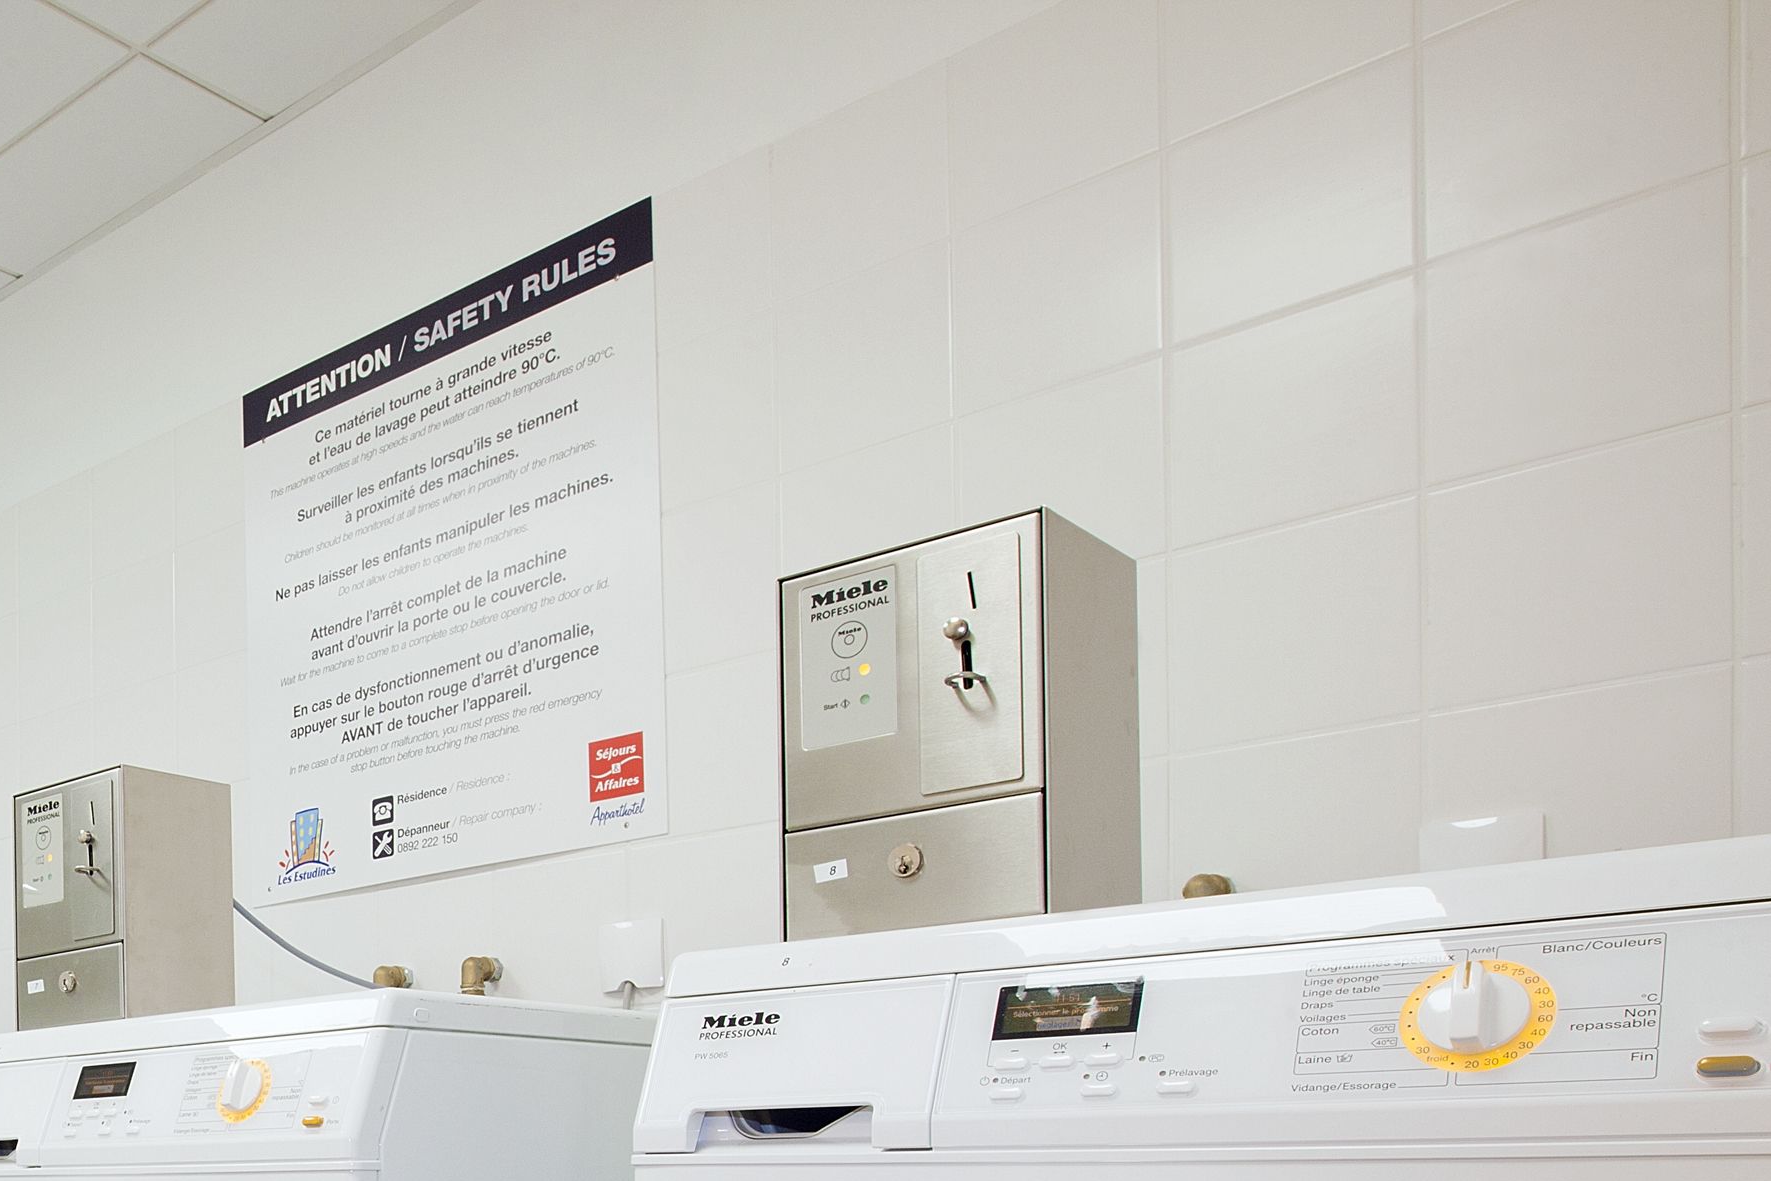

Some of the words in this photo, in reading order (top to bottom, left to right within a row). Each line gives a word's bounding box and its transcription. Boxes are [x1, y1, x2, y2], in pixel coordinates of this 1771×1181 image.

[266, 343, 390, 422] ATTENTION
[397, 335, 406, 361] /
[413, 284, 513, 351] SAFETY
[522, 237, 615, 302] RULES
[314, 429, 331, 443] Ce
[335, 401, 385, 435] matériel
[388, 385, 431, 411] tourne
[435, 376, 443, 391] à
[447, 355, 496, 388] grande
[500, 331, 552, 361] vitesse
[308, 451, 320, 465] et
[323, 439, 351, 459] l'eau
[355, 431, 371, 446] de
[374, 412, 416, 438] lavage
[420, 395, 450, 422] peut
[453, 368, 517, 404] atteindre
[521, 347, 560, 374] 90°C.
[297, 491, 353, 522] Surveiller
[356, 483, 374, 499] les
[378, 463, 426, 490] enfants
[430, 435, 492, 470] lorsqu'ils
[495, 427, 512, 443] se
[516, 398, 579, 434] tiennent
[344, 510, 352, 523] à
[356, 484, 415, 522] proximité
[419, 477, 443, 494] des
[447, 448, 518, 484] machines.
[275, 587, 290, 602] Ne
[293, 579, 315, 598] pas
[318, 563, 358, 586] laisser
[361, 556, 379, 570] les
[383, 537, 431, 562] enfants
[435, 510, 505, 544] manipuler
[509, 501, 529, 517] les
[534, 473, 613, 509] machines.
[310, 612, 362, 641] Attendre
[366, 599, 403, 623] l'arrêt
[406, 580, 461, 609] complet
[464, 575, 482, 590] de
[486, 569, 498, 583] la
[503, 548, 566, 578] machine
[811, 579, 888, 609] Miele
[811, 595, 889, 622] PROFESSIONAL
[311, 638, 343, 660] avant
[346, 623, 394, 648] d'ouvrir
[397, 619, 408, 632] la
[412, 608, 448, 631] porte
[452, 601, 469, 615] ou
[474, 595, 486, 608] le
[490, 570, 566, 603] couvercle.
[838, 626, 862, 636] Miele
[293, 704, 308, 718] En
[311, 698, 332, 712] cas
[335, 691, 351, 705] de
[354, 652, 481, 701] dysfonctionnement
[485, 648, 502, 662] ou
[507, 622, 593, 656] d'anomalie,
[290, 716, 337, 739] appuyer
[340, 709, 360, 724] sur
[363, 704, 374, 718] le
[378, 692, 423, 713] bouton
[428, 680, 467, 700] rouge
[471, 663, 518, 687] d'arrêt
[522, 644, 599, 674] d'urgence
[340, 720, 383, 744] AVANT
[386, 717, 403, 731] de
[406, 703, 458, 726] toucher
[462, 682, 531, 712] l'appareil.
[595, 744, 636, 760] Séjours
[594, 776, 639, 792] Affaires
[396, 784, 447, 805] Résidence
[27, 800, 60, 816] Miele
[589, 797, 645, 826] Apparthotel
[27, 812, 60, 824] PROFESSIONAL
[397, 820, 450, 840] Dépanneur
[397, 839, 419, 853] 0892
[421, 835, 438, 849] 222
[442, 831, 458, 845] 150
[277, 869, 292, 885] Les
[293, 863, 336, 882] Estudines
[829, 865, 837, 876] 8
[1470, 946, 1496, 954] Arrêt
[1542, 936, 1662, 954] Blanc/Couleurs
[781, 957, 790, 967] 8
[1493, 964, 1508, 972] 95
[1511, 967, 1525, 976] 75
[1303, 977, 1334, 988] Linge
[1336, 974, 1380, 986] éponge
[1524, 976, 1540, 984] 60
[1302, 988, 1332, 998] Linge
[1335, 987, 1349, 996] de
[1351, 985, 1381, 994] table
[1534, 986, 1550, 995] 40
[1641, 993, 1658, 1002] °C
[1300, 1001, 1334, 1011] Draps
[1538, 1000, 1554, 1008] 30
[1299, 1013, 1347, 1024] Voilages
[1537, 1014, 1554, 1022] 60
[1624, 1008, 1657, 1018] Non
[701, 1011, 780, 1029] Miele
[1570, 1018, 1656, 1032] repassable
[698, 1027, 777, 1040] PROFESSIONAL
[1301, 1027, 1339, 1036] Coton
[1530, 1028, 1546, 1036] 40
[1052, 1042, 1068, 1050] OK
[1416, 1046, 1430, 1054] 30
[1518, 1041, 1534, 1049] 30
[694, 1052, 707, 1060] PW
[1298, 1055, 1332, 1064] Laine
[1426, 1055, 1449, 1063] froid
[1503, 1051, 1518, 1059] 40
[1630, 1052, 1654, 1061] Fin
[1464, 1061, 1479, 1069] 20
[1484, 1058, 1499, 1066] 30
[1168, 1068, 1219, 1077] Prélavage
[1000, 1076, 1031, 1085] Départ
[1291, 1081, 1397, 1093] Vidange/Essorage
